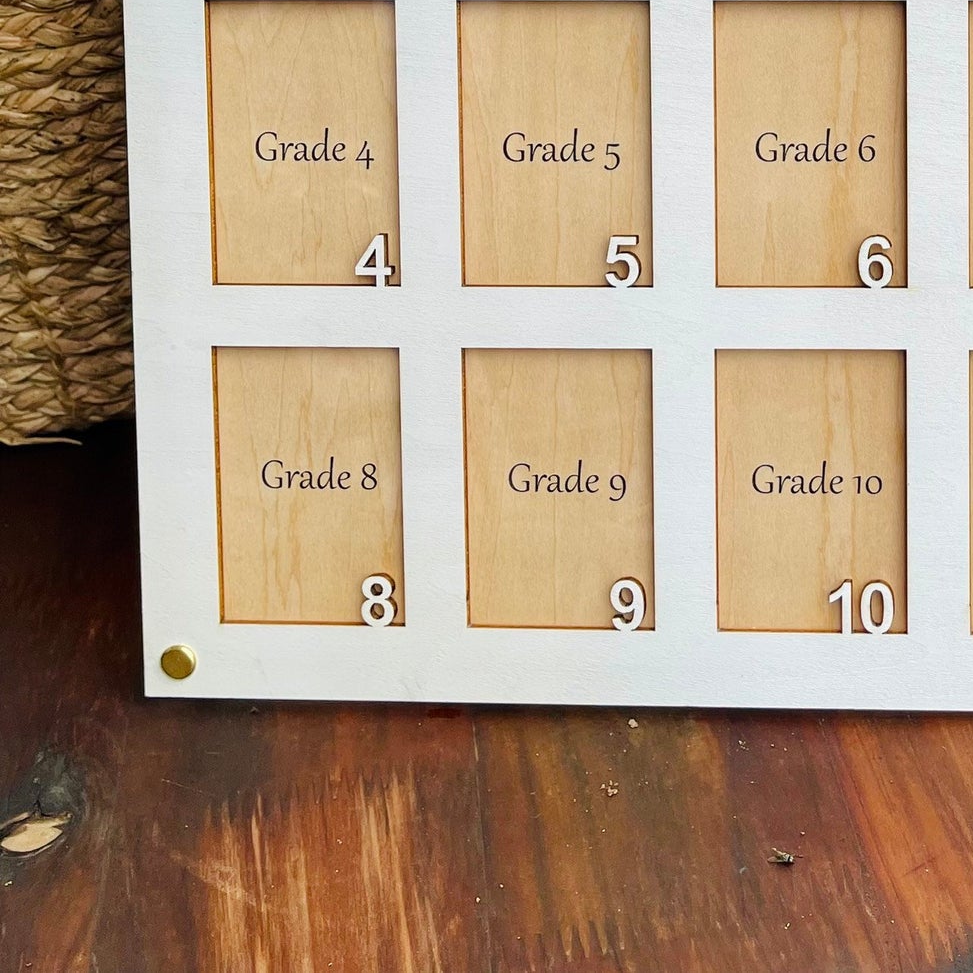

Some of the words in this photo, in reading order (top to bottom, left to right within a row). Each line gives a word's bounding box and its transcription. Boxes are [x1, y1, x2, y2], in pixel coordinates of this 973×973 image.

[255, 127, 347, 162] Grade
[355, 140, 375, 170] 4
[502, 128, 595, 163] Grade
[604, 142, 621, 171] 5
[755, 128, 848, 163] Grade
[858, 134, 876, 163] 6
[355, 233, 393, 286] 4
[605, 235, 641, 288] 5
[857, 235, 894, 288] 6
[261, 456, 351, 491] Grade
[362, 461, 378, 490] 8
[508, 460, 600, 494] Grade
[609, 473, 627, 501] 9
[751, 461, 844, 495] Grade
[852, 476, 884, 495] 10
[360, 573, 396, 627] 8
[610, 578, 647, 631] 9
[828, 579, 895, 634] 10
